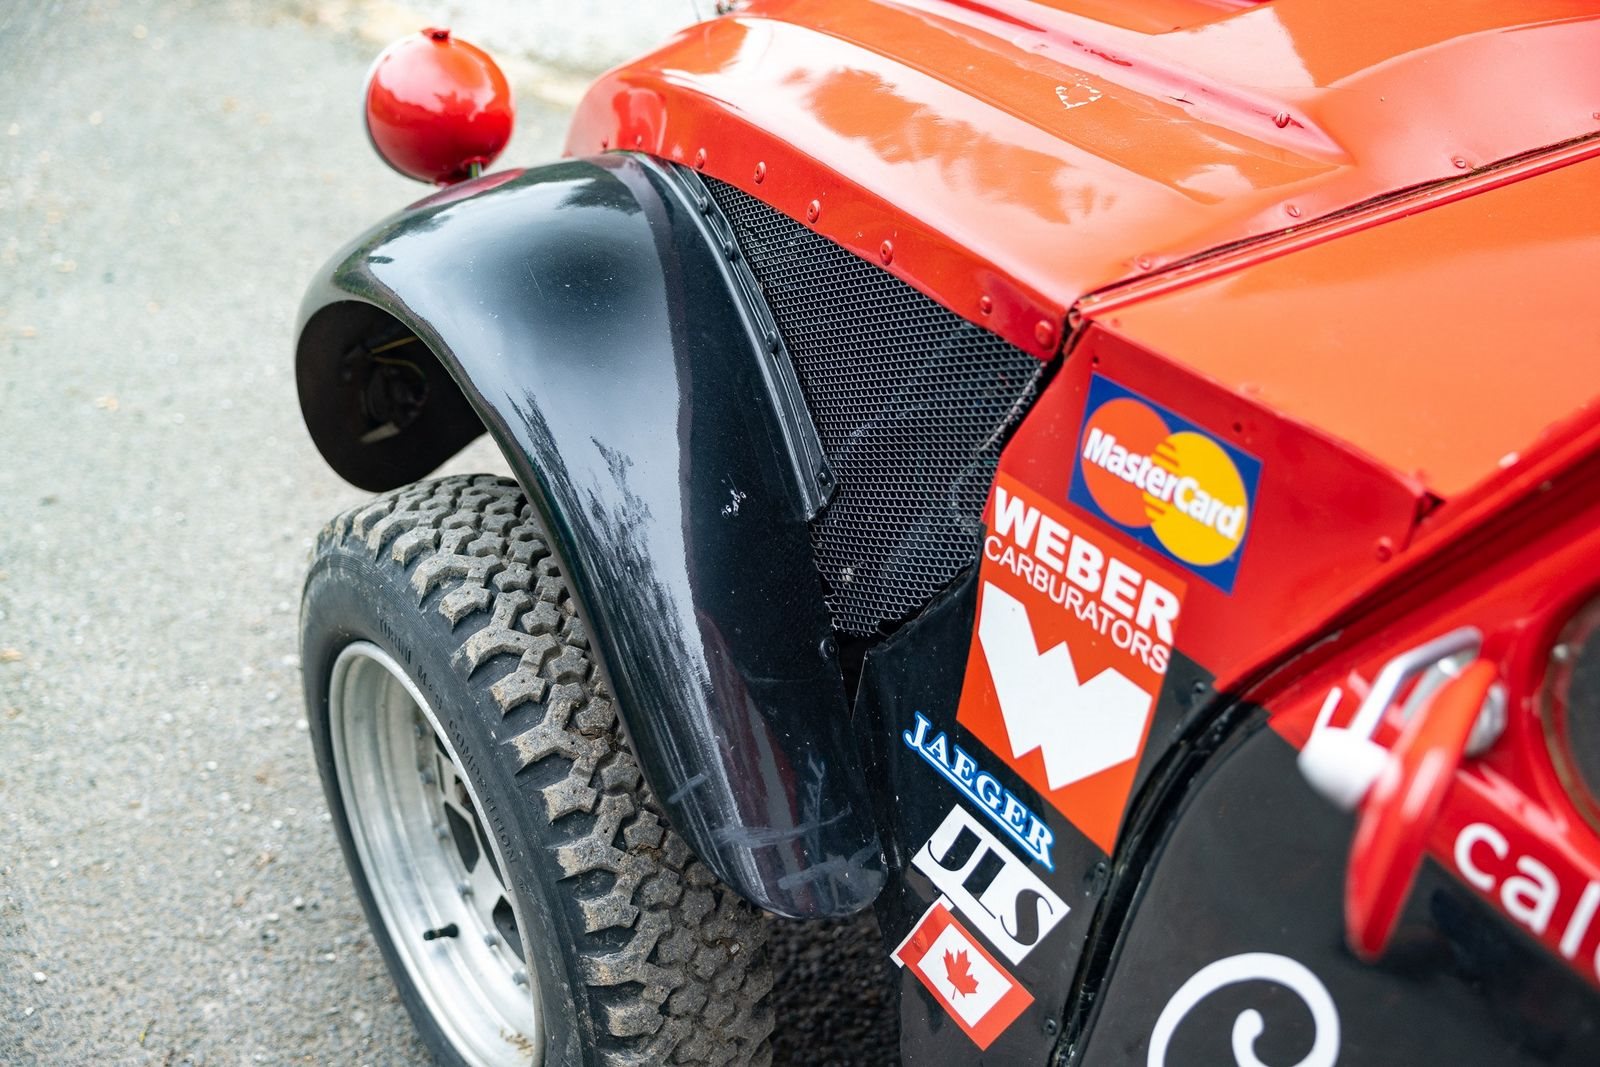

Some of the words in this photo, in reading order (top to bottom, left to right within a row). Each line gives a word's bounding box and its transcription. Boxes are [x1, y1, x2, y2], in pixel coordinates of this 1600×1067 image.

[1082, 427, 1244, 540] MasterCard
[984, 536, 1169, 674] CARBURATORS
[995, 486, 1181, 643] WEBER
[904, 711, 1054, 870] JAEGER
[927, 825, 1053, 946] JLS
[1454, 822, 1600, 984] cal
